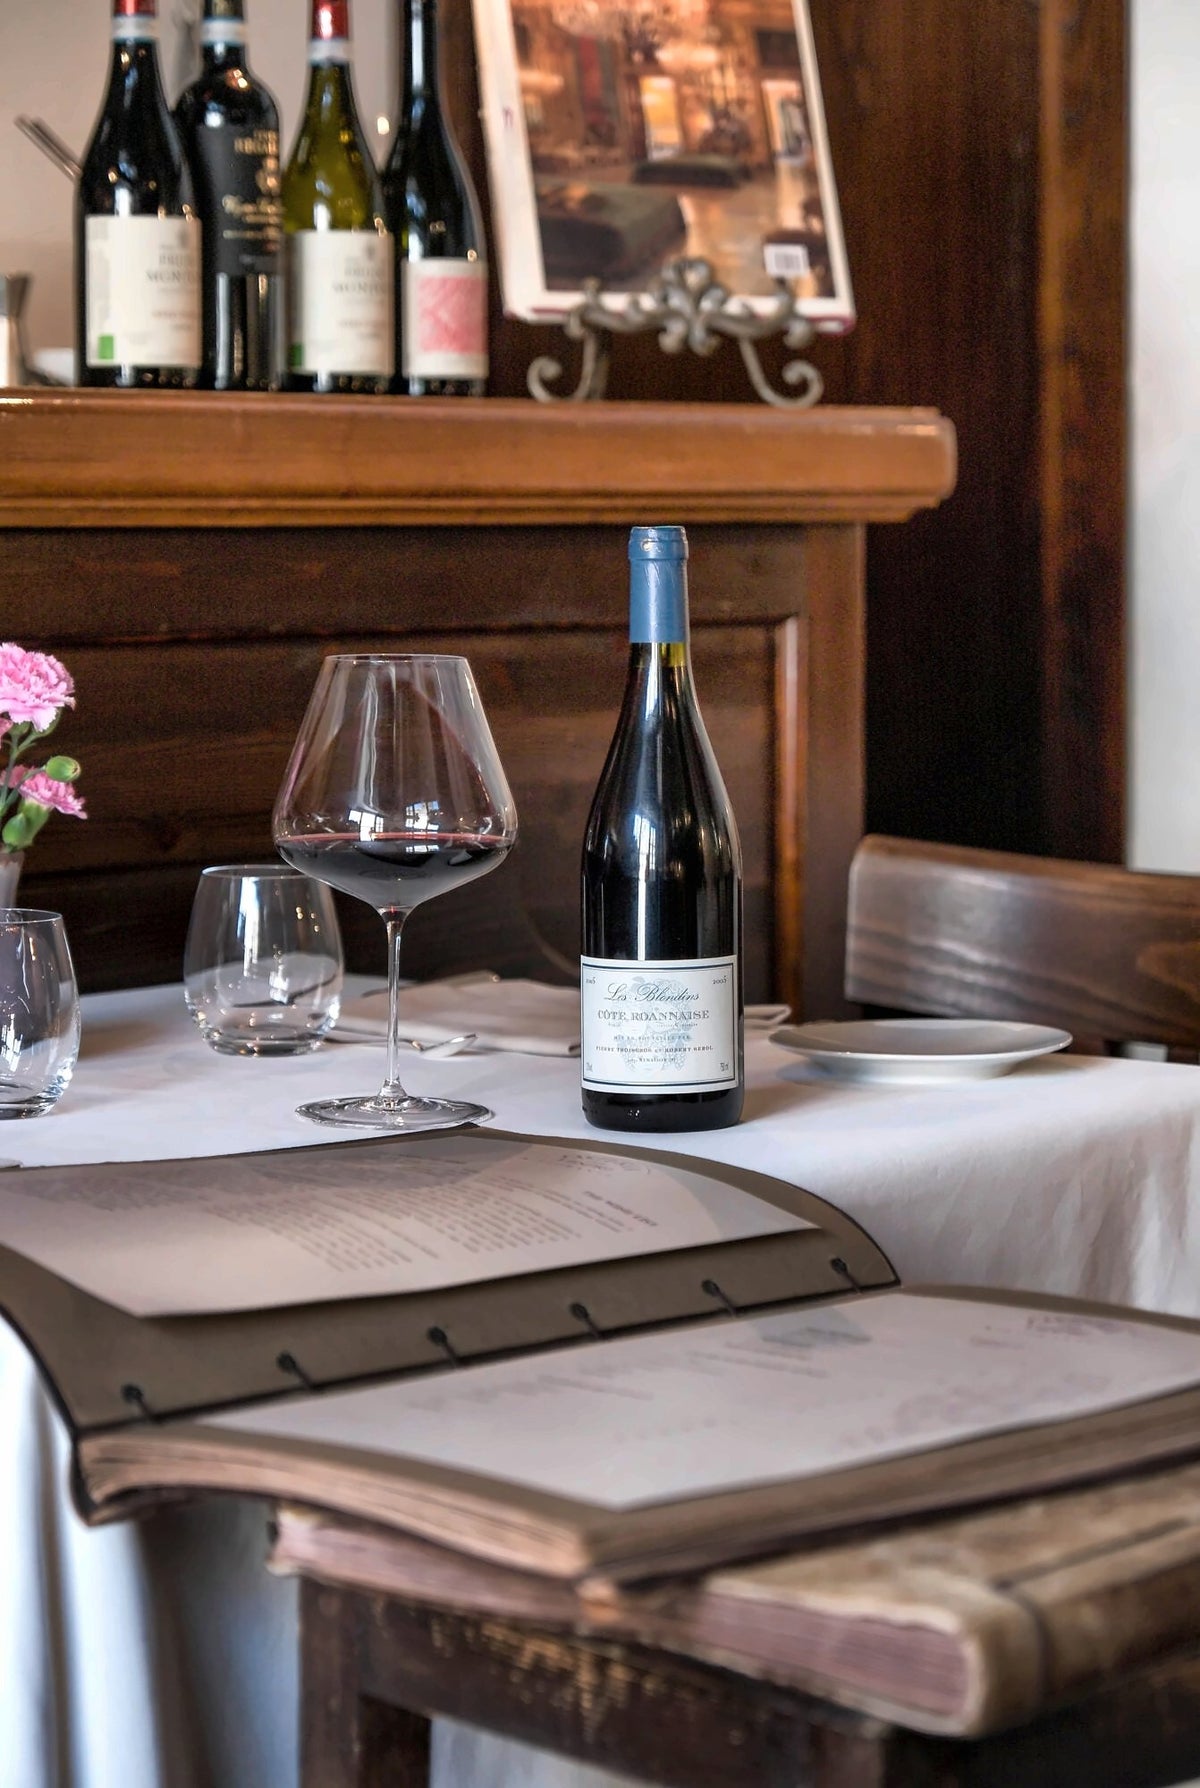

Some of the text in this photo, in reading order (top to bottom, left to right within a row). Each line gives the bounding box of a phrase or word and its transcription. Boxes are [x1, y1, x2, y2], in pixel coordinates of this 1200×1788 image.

[604, 982, 701, 1002] Les Blondins
[598, 1009, 710, 1022] CÔTE ROANNAISE
